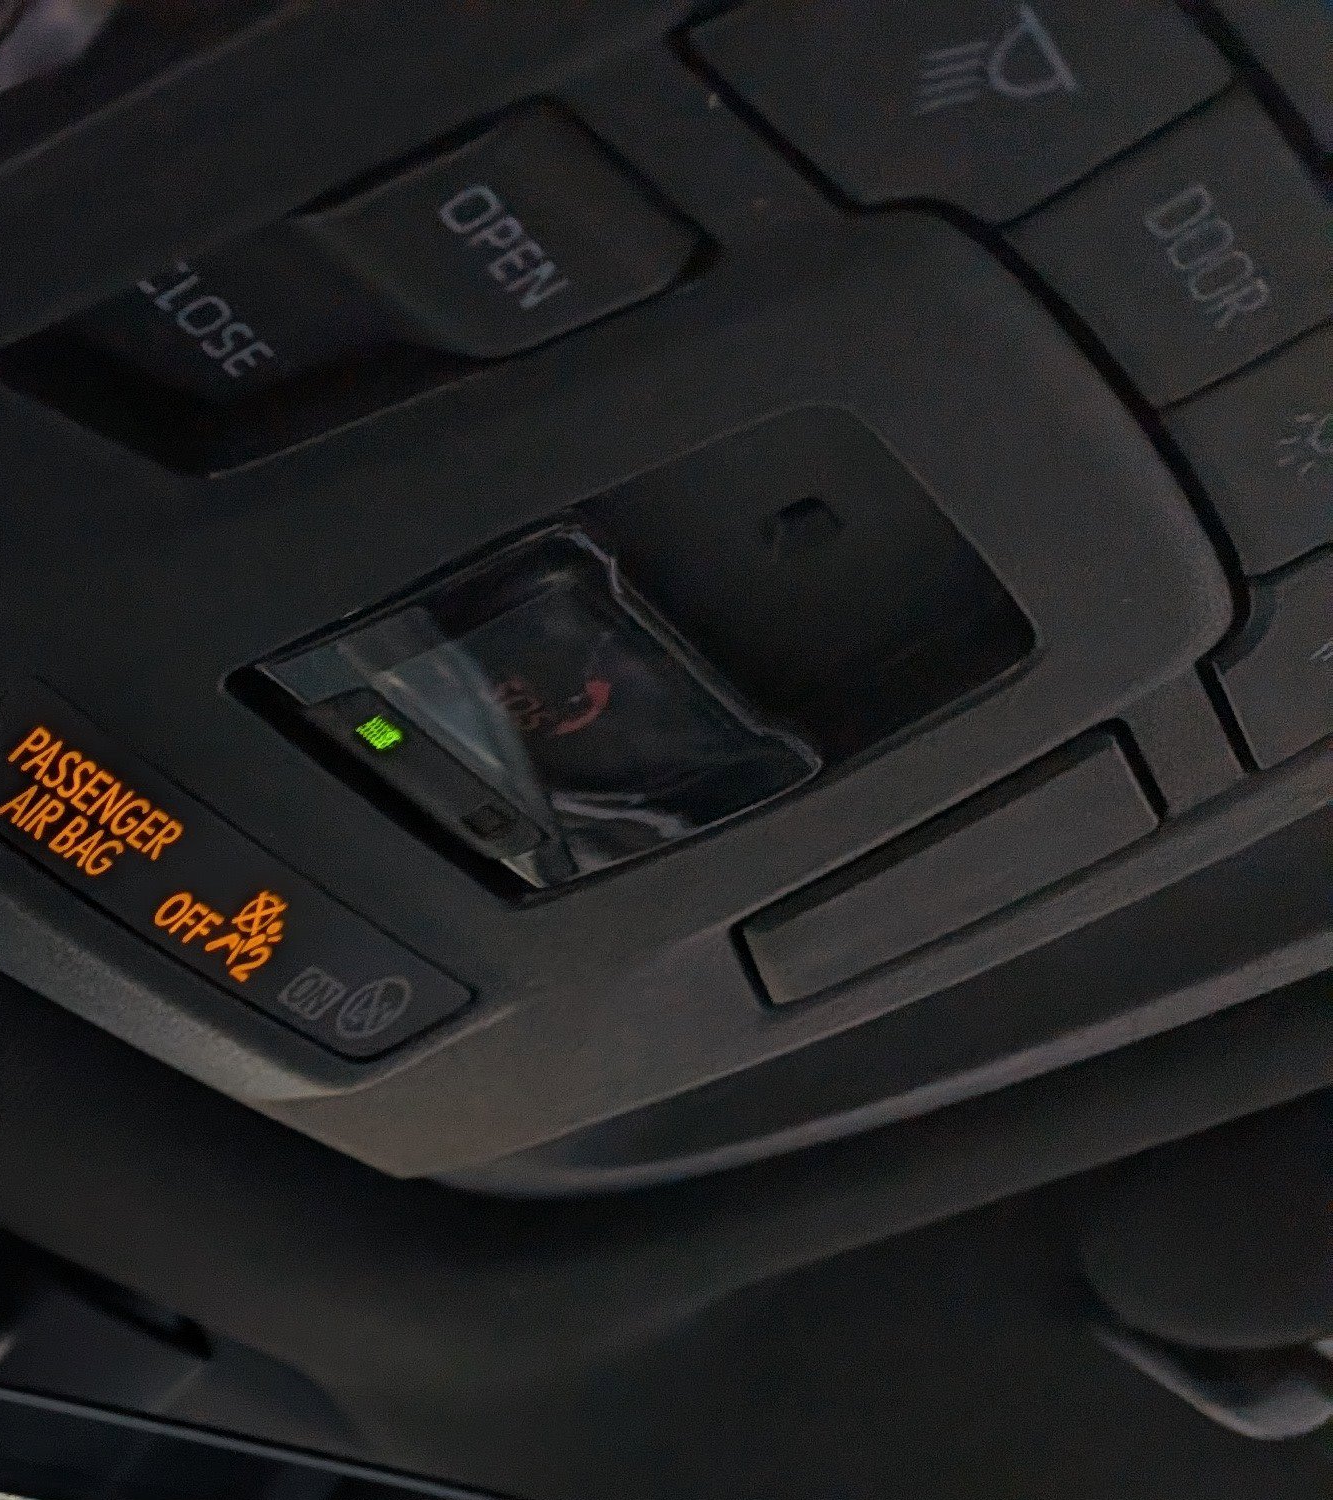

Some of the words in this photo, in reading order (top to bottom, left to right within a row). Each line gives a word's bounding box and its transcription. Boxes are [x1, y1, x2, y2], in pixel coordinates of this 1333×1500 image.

[437, 183, 572, 311] OPEN
[1143, 185, 1270, 330] DOOR
[7, 726, 184, 861] PASSENGER
[48, 827, 126, 877] BAG
[154, 891, 226, 944] OFF
